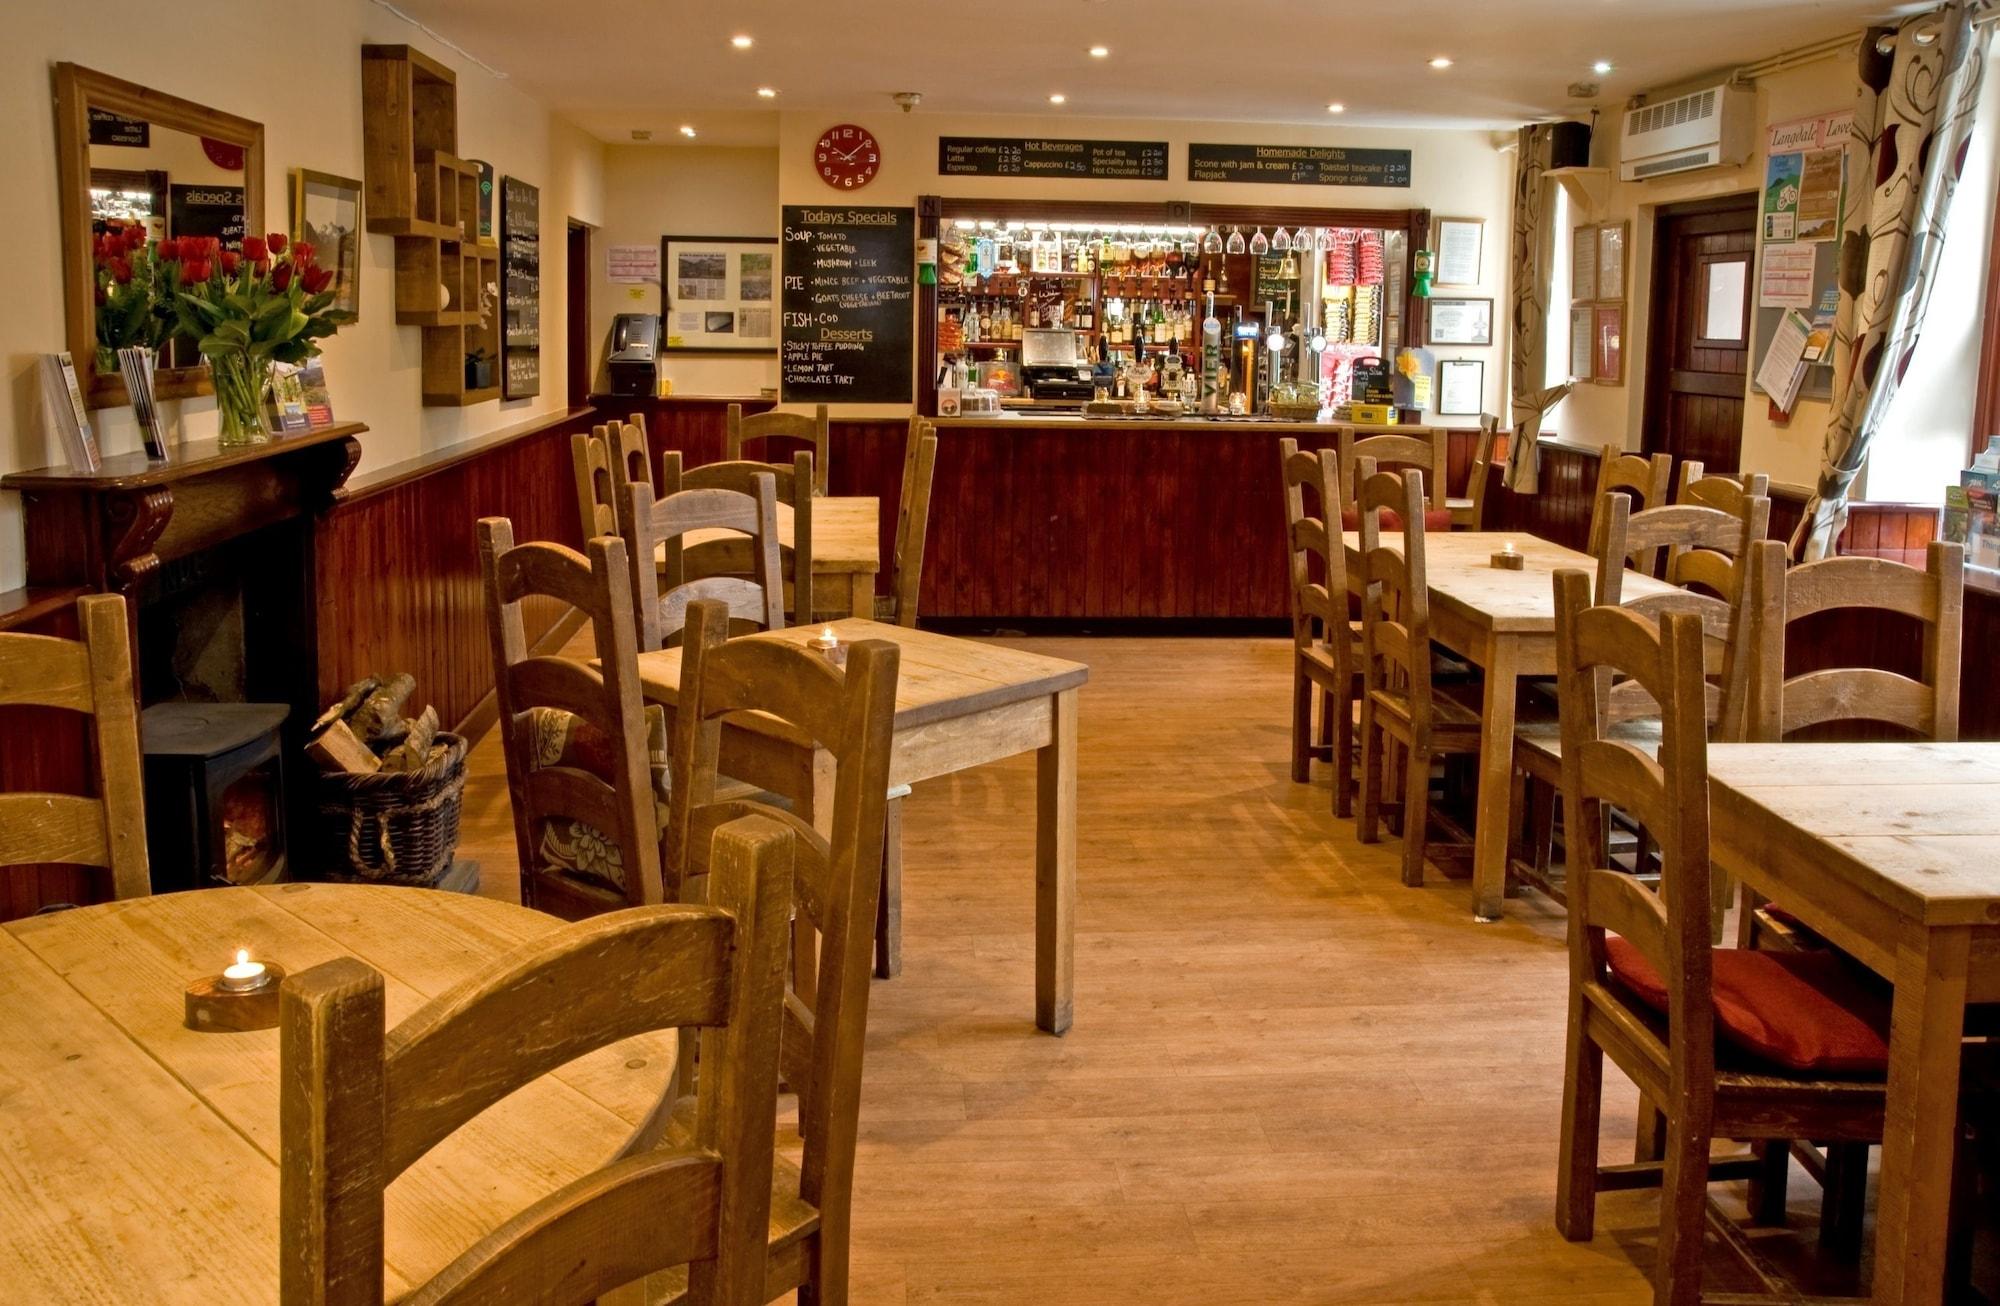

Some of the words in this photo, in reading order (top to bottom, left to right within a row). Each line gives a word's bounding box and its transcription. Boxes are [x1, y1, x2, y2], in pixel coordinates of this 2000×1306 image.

[832, 131, 839, 140] 11
[843, 129, 853, 138] 12
[859, 131, 863, 140] 1
[1772, 123, 1815, 147] Langdale
[821, 139, 830, 148] 10
[865, 139, 872, 148] 2
[1024, 141, 1040, 151] Hot
[1041, 141, 1084, 152] Beverages
[947, 145, 973, 154] Regular
[975, 145, 996, 153] coffee
[1092, 147, 1104, 157] Pot
[1105, 147, 1113, 156] of
[1114, 149, 1126, 157] tea
[1256, 147, 1307, 158] Homemade
[1309, 149, 1346, 160] Delights
[819, 153, 827, 162] 9
[868, 153, 877, 162] 3
[947, 154, 965, 162] Latte
[1092, 157, 1124, 168] Speciality
[1126, 158, 1138, 166] tea
[947, 163, 978, 173] Espresso
[1024, 160, 1063, 169] Cappuccino
[1194, 159, 1219, 168] Scone
[1220, 160, 1237, 169] with
[1240, 161, 1255, 170] jam
[1256, 161, 1263, 169] &
[1265, 162, 1290, 170] cream
[1319, 162, 1350, 172] Toasted
[1351, 163, 1382, 172] teacake
[824, 167, 831, 176] 8
[865, 166, 872, 175] 4
[1092, 167, 1105, 175] Hot
[1106, 167, 1140, 175] Chocolate
[1194, 170, 1227, 180] Flapjack
[832, 174, 839, 184] 7
[844, 177, 852, 187] 6
[857, 174, 864, 183] 5
[1319, 172, 1348, 183] Sponge
[1350, 174, 1369, 183] cake
[801, 209, 844, 225] Todays
[847, 211, 897, 226] Specials
[818, 231, 847, 241] TOMATO
[816, 259, 852, 269] MUSHROOM
[784, 275, 804, 290] PIE
[814, 277, 839, 287] MINCE
[841, 276, 860, 286] BEEF
[815, 293, 840, 304] GOATS
[783, 312, 812, 328] FISH
[819, 312, 839, 324] COD
[820, 327, 873, 340] Desserts
[786, 340, 810, 352] STICKY
[788, 352, 809, 361] APPLE
[811, 352, 823, 361] PIE
[787, 364, 814, 373] LEMON
[817, 363, 835, 372] TART
[1204, 344, 1218, 396] VIER
[788, 375, 832, 384] CHOCOLATE
[834, 375, 855, 385] TART
